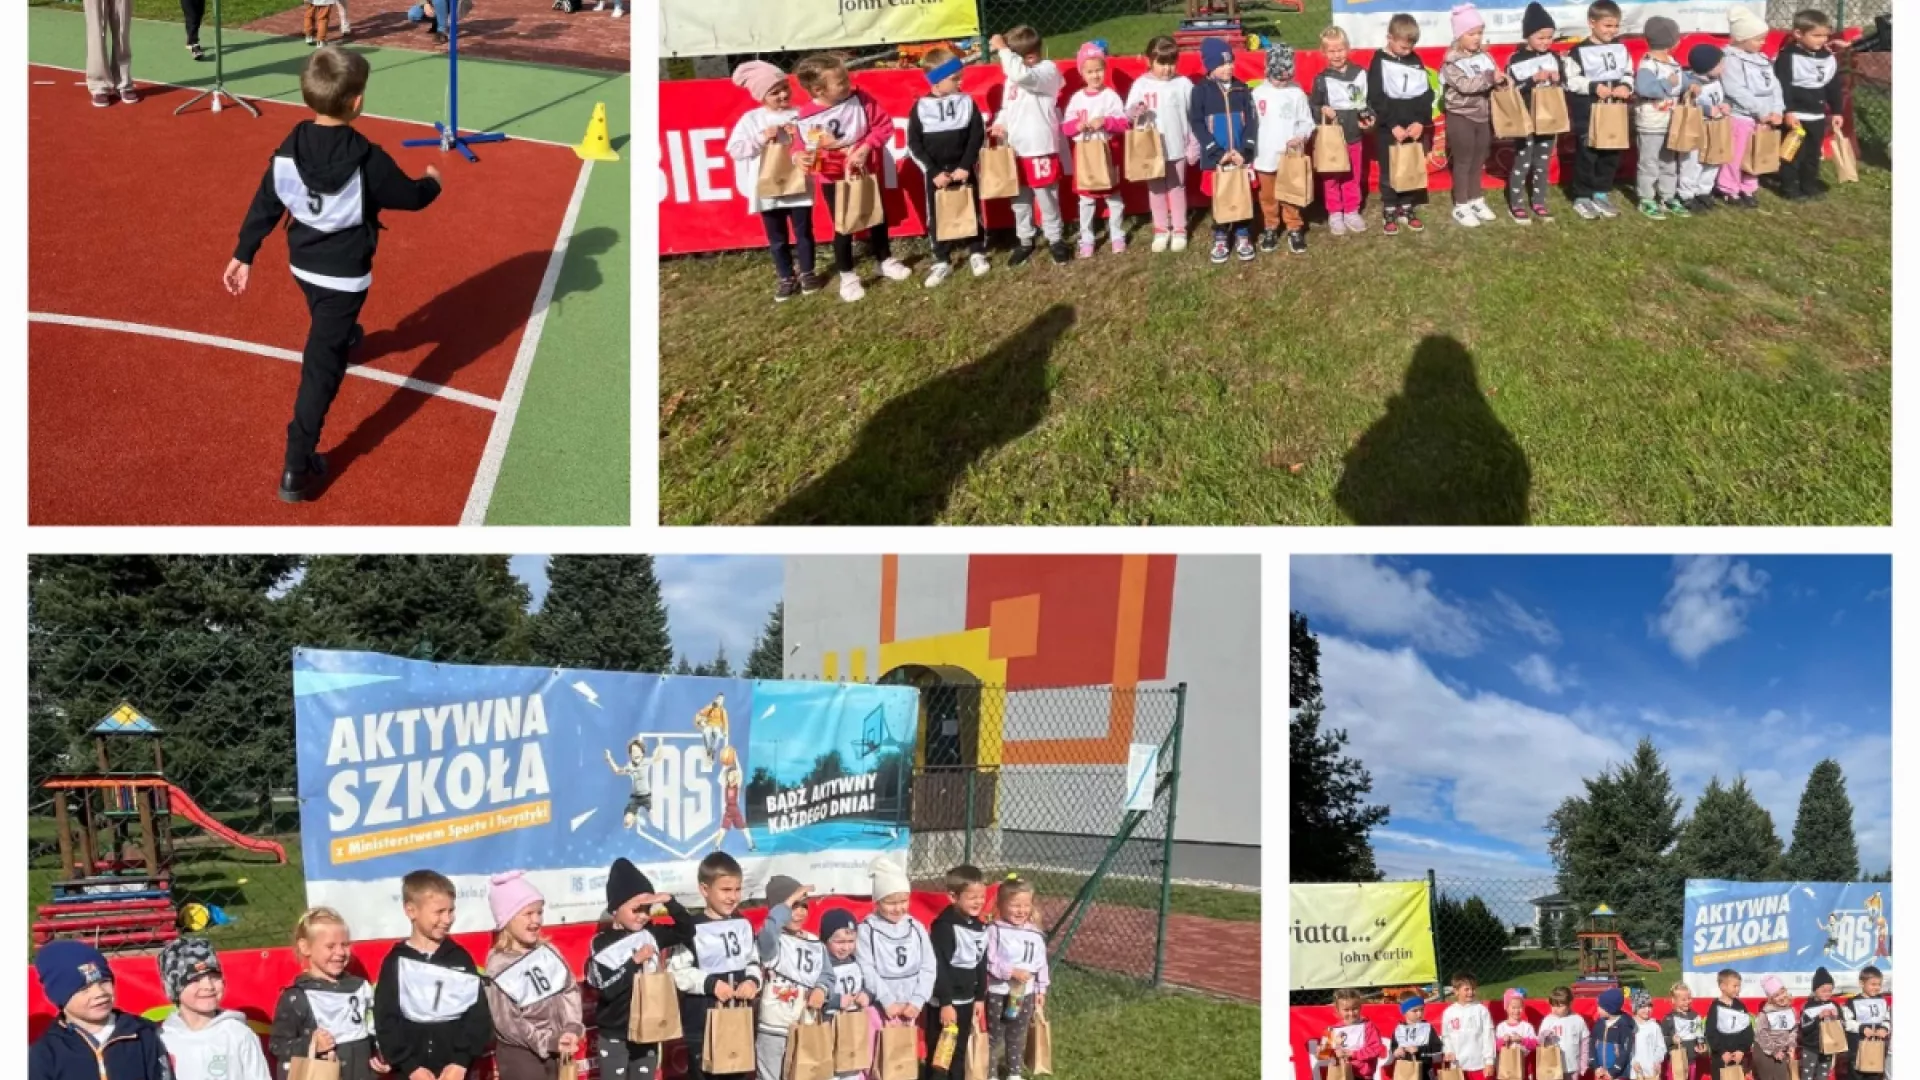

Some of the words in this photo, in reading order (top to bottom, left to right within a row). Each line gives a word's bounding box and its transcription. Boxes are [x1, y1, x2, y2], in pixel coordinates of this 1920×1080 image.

[1600, 51, 1617, 71] 13
[936, 99, 957, 121] 14
[828, 118, 845, 139] 2
[1032, 158, 1051, 180] 13
[325, 693, 549, 766] AKTYWNA
[327, 741, 550, 832] SZKOŁA
[650, 744, 714, 842] AS
[811, 772, 878, 802] AKTYWNY
[767, 802, 828, 835] KAŻDEGO
[829, 792, 876, 817] DNIA!
[348, 828, 446, 855] Ministerstwem
[1695, 894, 1790, 926] AKTYWNA
[1289, 918, 1387, 943] iata...“
[1693, 915, 1789, 953] SZKOŁA
[719, 931, 742, 958] 13
[895, 945, 908, 967] 6
[1022, 939, 1035, 964] 11
[1340, 950, 1371, 966] John
[1374, 947, 1414, 962] Carlin
[795, 947, 814, 973] 15
[523, 966, 552, 997] 16
[431, 980, 443, 1011] 1
[347, 995, 363, 1024] 3
